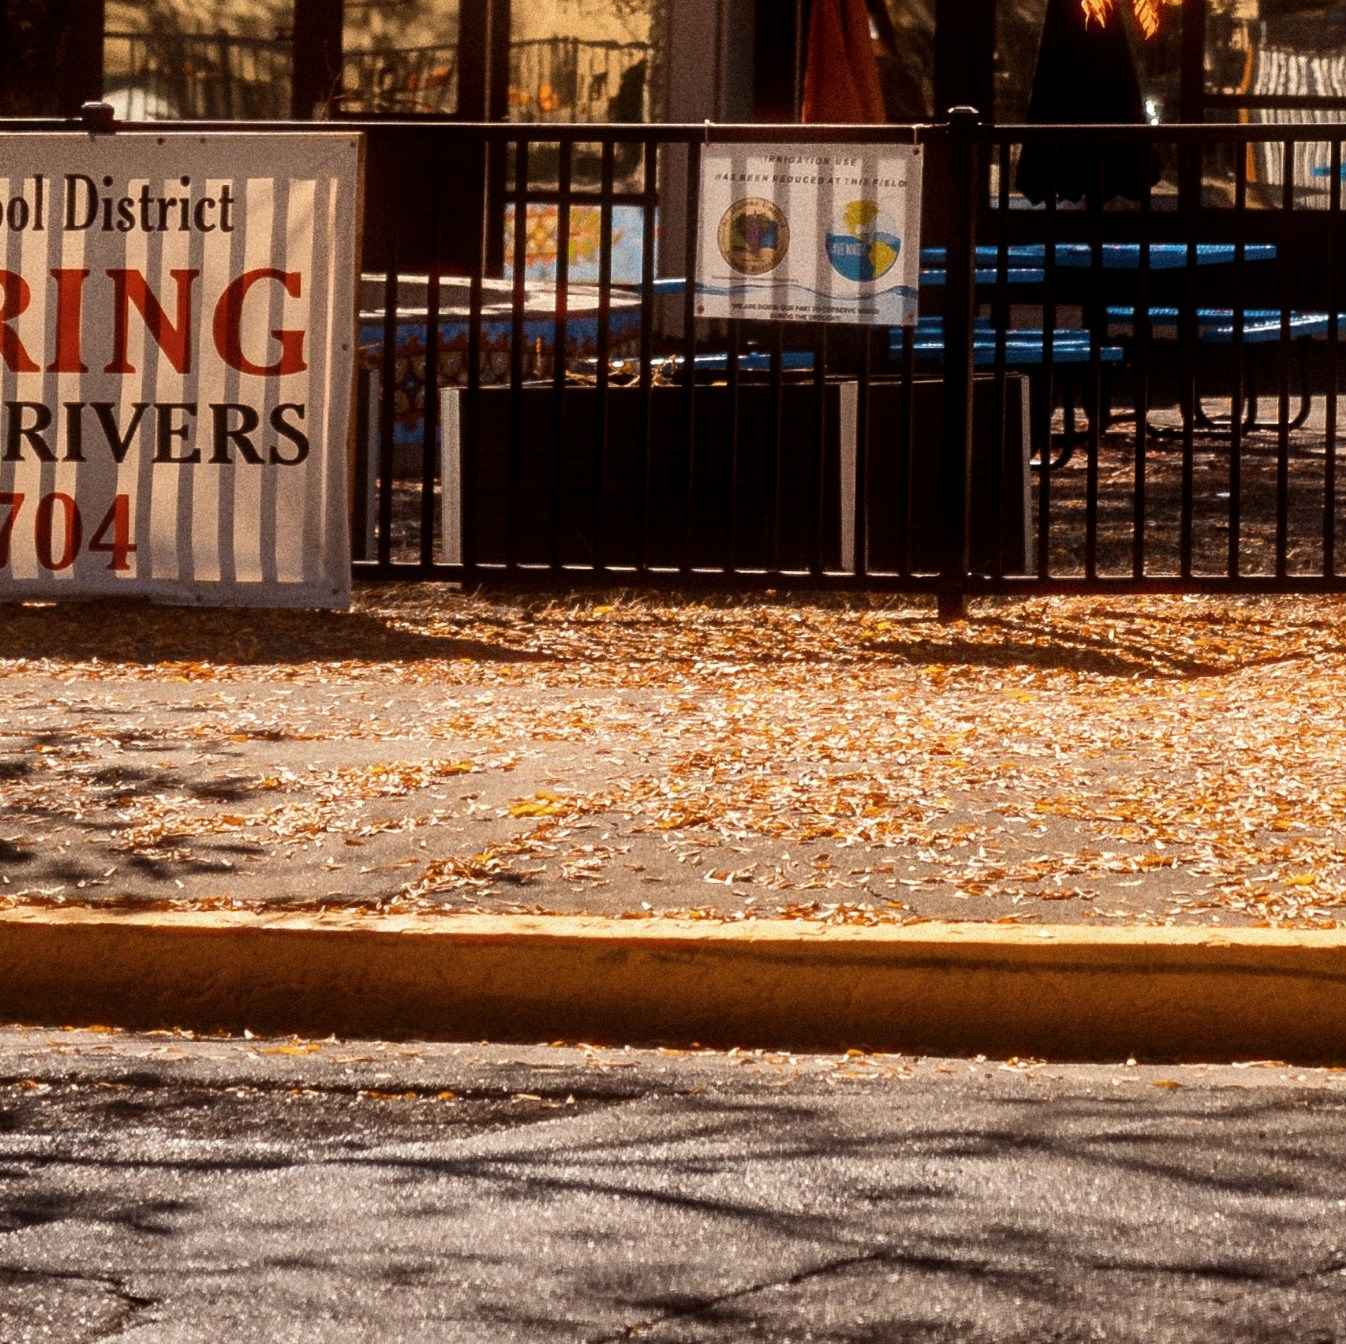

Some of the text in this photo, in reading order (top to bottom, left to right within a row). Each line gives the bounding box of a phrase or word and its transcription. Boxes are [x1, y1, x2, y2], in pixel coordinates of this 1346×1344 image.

[0, 173, 234, 233] ol District
[771, 174, 825, 185] REDUCED
[2, 400, 310, 466] RIVERS
